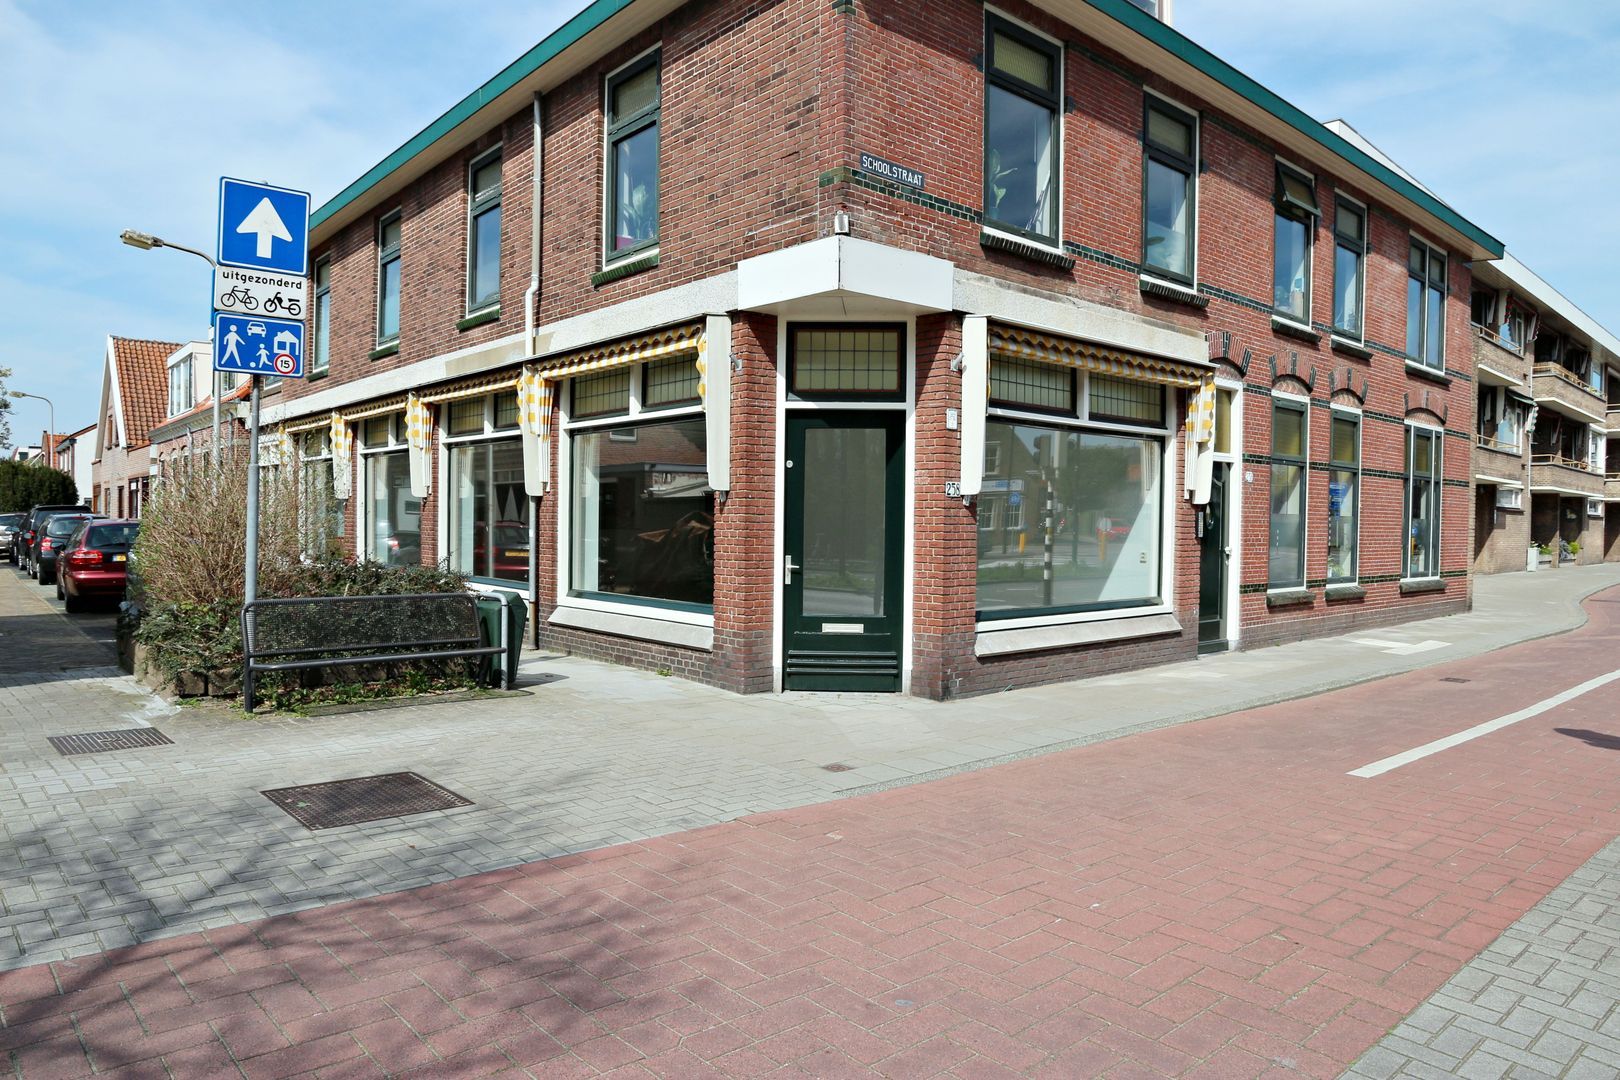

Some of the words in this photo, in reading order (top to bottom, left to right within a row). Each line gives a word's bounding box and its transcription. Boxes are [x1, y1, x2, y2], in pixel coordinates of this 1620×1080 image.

[862, 155, 923, 186] SCHOOLSTRAAT
[222, 270, 302, 290] uitgezonderd
[280, 359, 291, 369] 15
